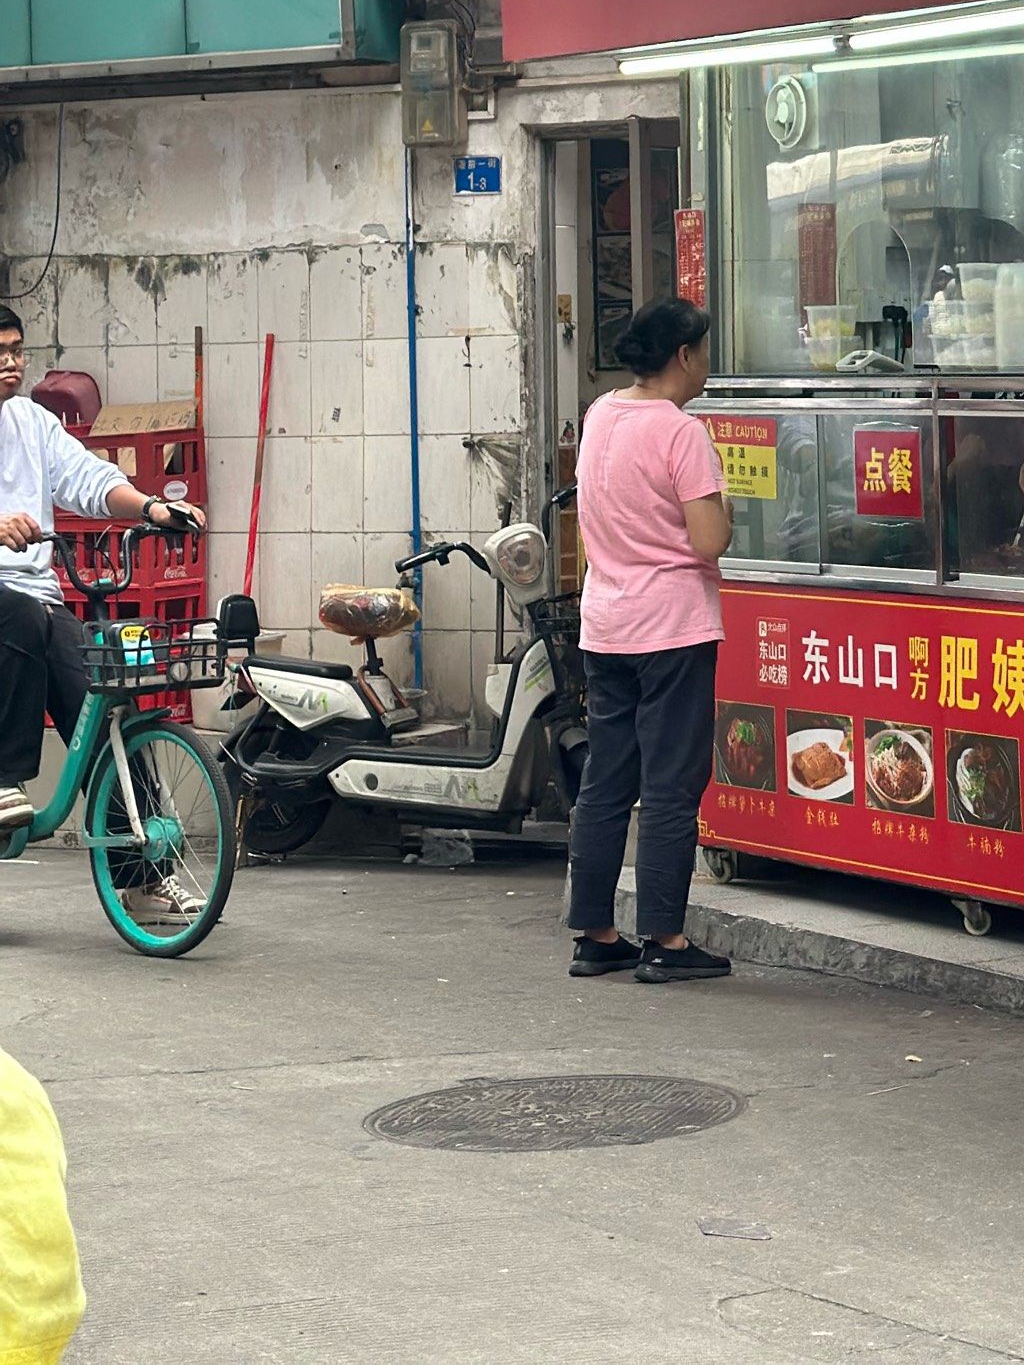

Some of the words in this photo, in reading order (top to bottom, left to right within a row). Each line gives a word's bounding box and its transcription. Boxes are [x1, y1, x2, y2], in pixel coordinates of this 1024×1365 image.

[735, 425, 768, 440] CAUTION
[863, 447, 913, 495] 点餐
[758, 639, 787, 661] 东山口
[801, 629, 898, 690] 东山口
[758, 663, 788, 686] 必吃榜
